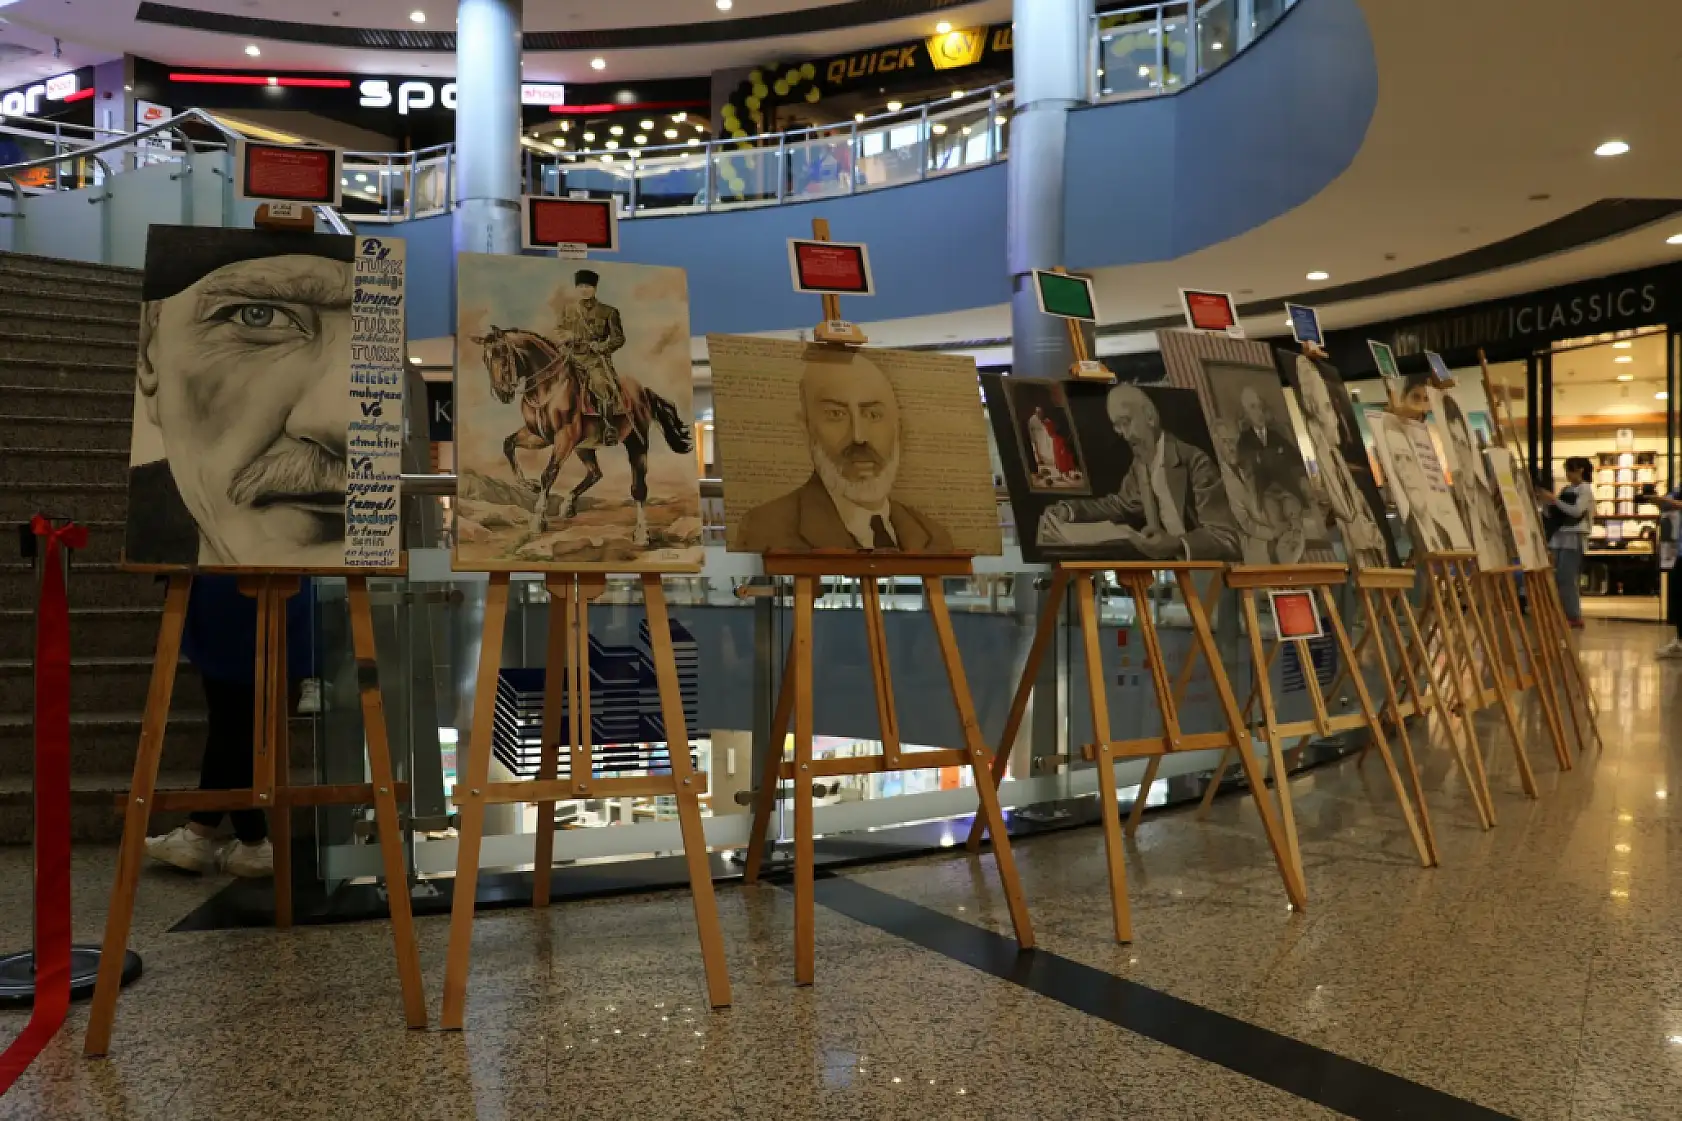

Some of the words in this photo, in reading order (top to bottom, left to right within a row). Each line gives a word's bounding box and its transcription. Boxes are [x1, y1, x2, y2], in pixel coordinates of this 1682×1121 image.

[827, 45, 917, 84] QUICK
[0, 85, 45, 116] or
[359, 79, 456, 115] sp
[1517, 284, 1656, 334] CLASSICS
